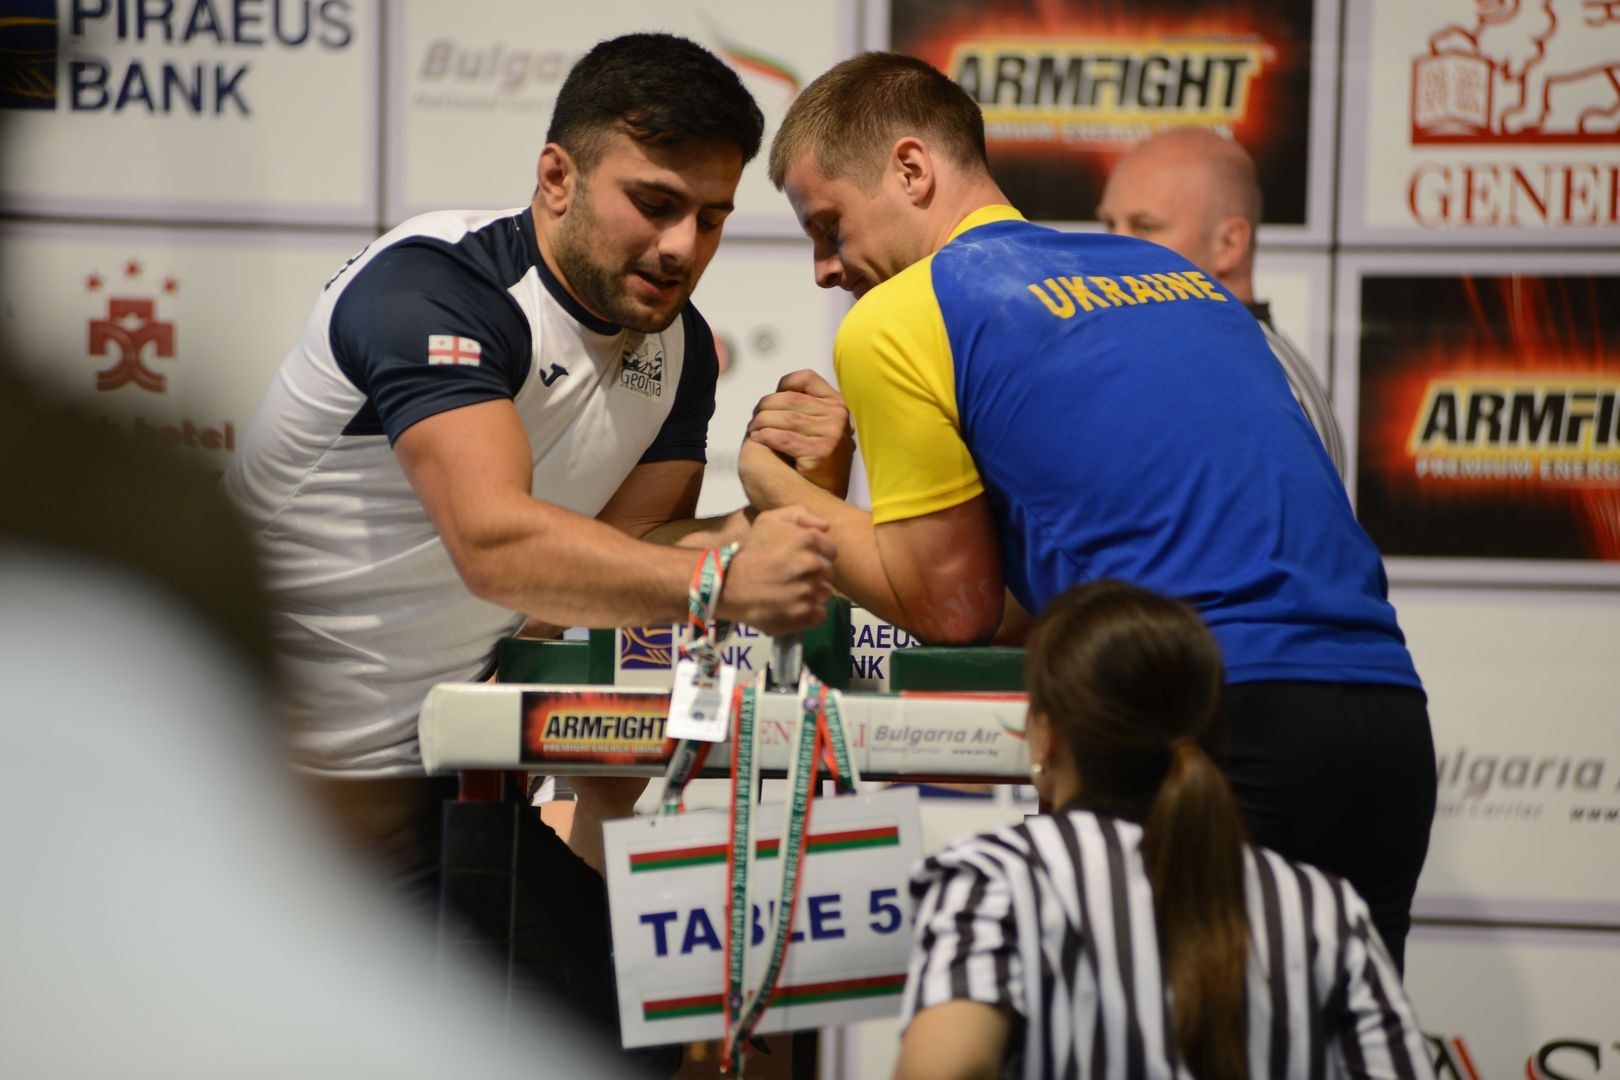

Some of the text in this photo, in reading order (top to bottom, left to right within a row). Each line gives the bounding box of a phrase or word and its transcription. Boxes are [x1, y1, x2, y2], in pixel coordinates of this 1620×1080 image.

[70, 0, 356, 48] PIRAEUS
[69, 61, 251, 114] BANK
[418, 38, 566, 94] Bulga
[954, 54, 1250, 109] ARMFIGHT
[1027, 271, 1228, 319] UKRAINE
[1420, 392, 1620, 444] ARMFI
[1415, 458, 1620, 481] PREMIUM ENERG
[850, 655, 884, 680] NK
[546, 715, 668, 740] ARMFIGHT
[875, 724, 967, 746] Bulgaria
[970, 728, 1001, 744] Air
[1437, 749, 1605, 799] lgaria
[869, 888, 902, 934] 5
